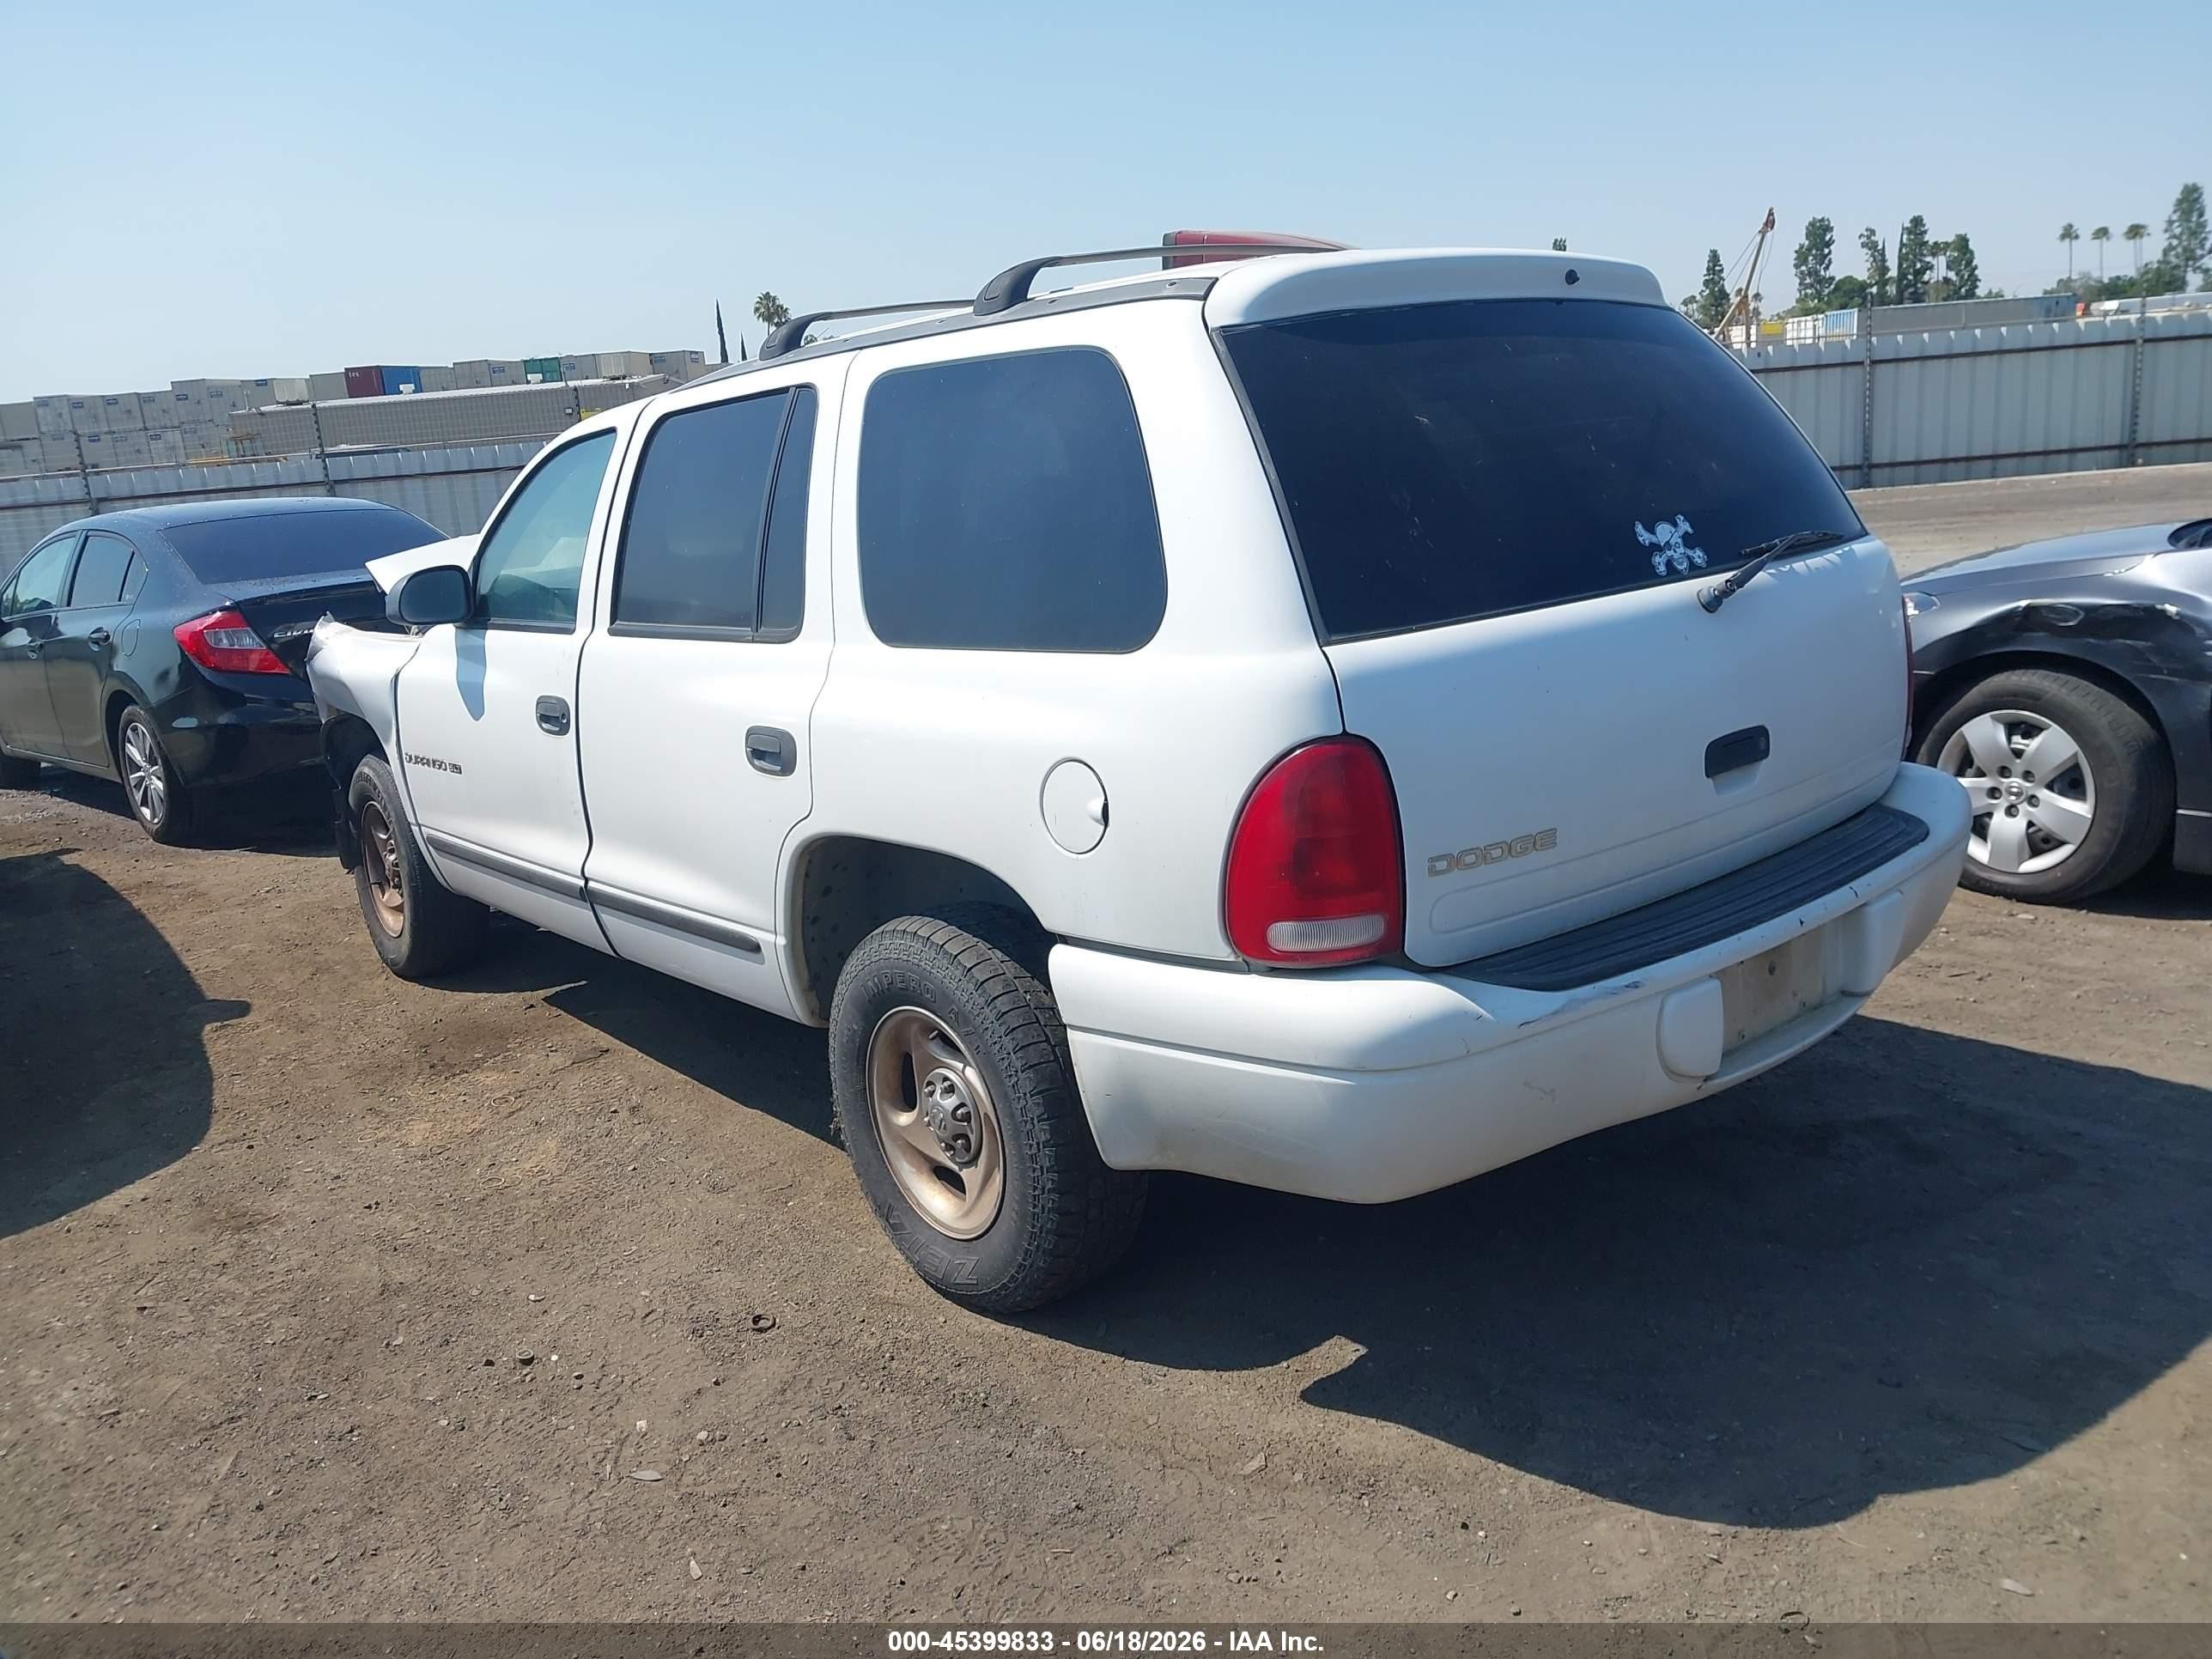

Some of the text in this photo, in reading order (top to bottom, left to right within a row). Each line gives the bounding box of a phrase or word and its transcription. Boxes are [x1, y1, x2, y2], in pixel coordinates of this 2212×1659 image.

[1427, 828, 1558, 878] DODGE
[860, 969, 937, 1003] IMPERO
[884, 1202, 981, 1285] ZETA
